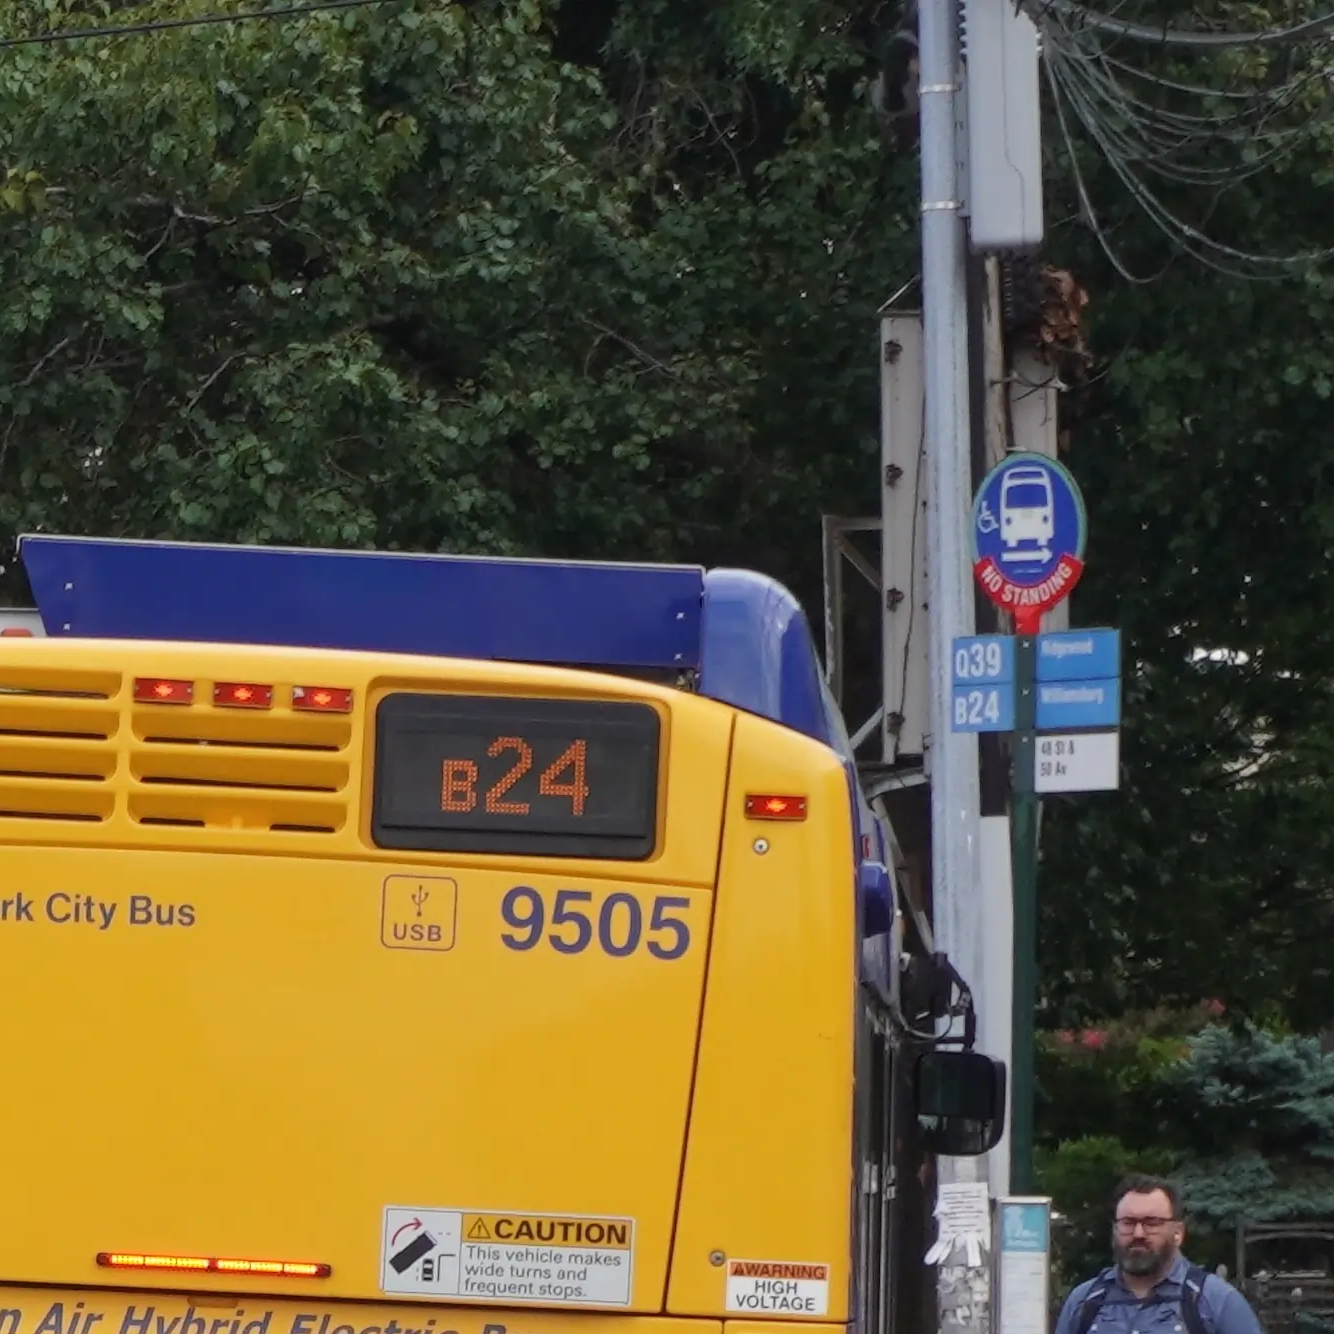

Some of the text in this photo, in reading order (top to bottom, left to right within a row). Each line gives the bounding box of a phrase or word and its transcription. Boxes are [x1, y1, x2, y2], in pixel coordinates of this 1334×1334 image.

[981, 563, 1072, 606] NO STANDING
[955, 642, 1001, 678] Q39
[955, 690, 999, 725] B24
[441, 736, 589, 816] B24
[46, 892, 117, 930] City
[129, 895, 196, 927] Bus
[501, 886, 691, 960] 9505
[393, 922, 442, 942] USB
[494, 1219, 627, 1245] CAUTION
[466, 1245, 621, 1267] This vehicle makes
[465, 1262, 587, 1281] wide turns and
[747, 1263, 826, 1280] WARNING
[465, 1278, 587, 1299] frequent stops.
[755, 1280, 797, 1295] HIGH
[736, 1294, 816, 1311] VOLTAGE
